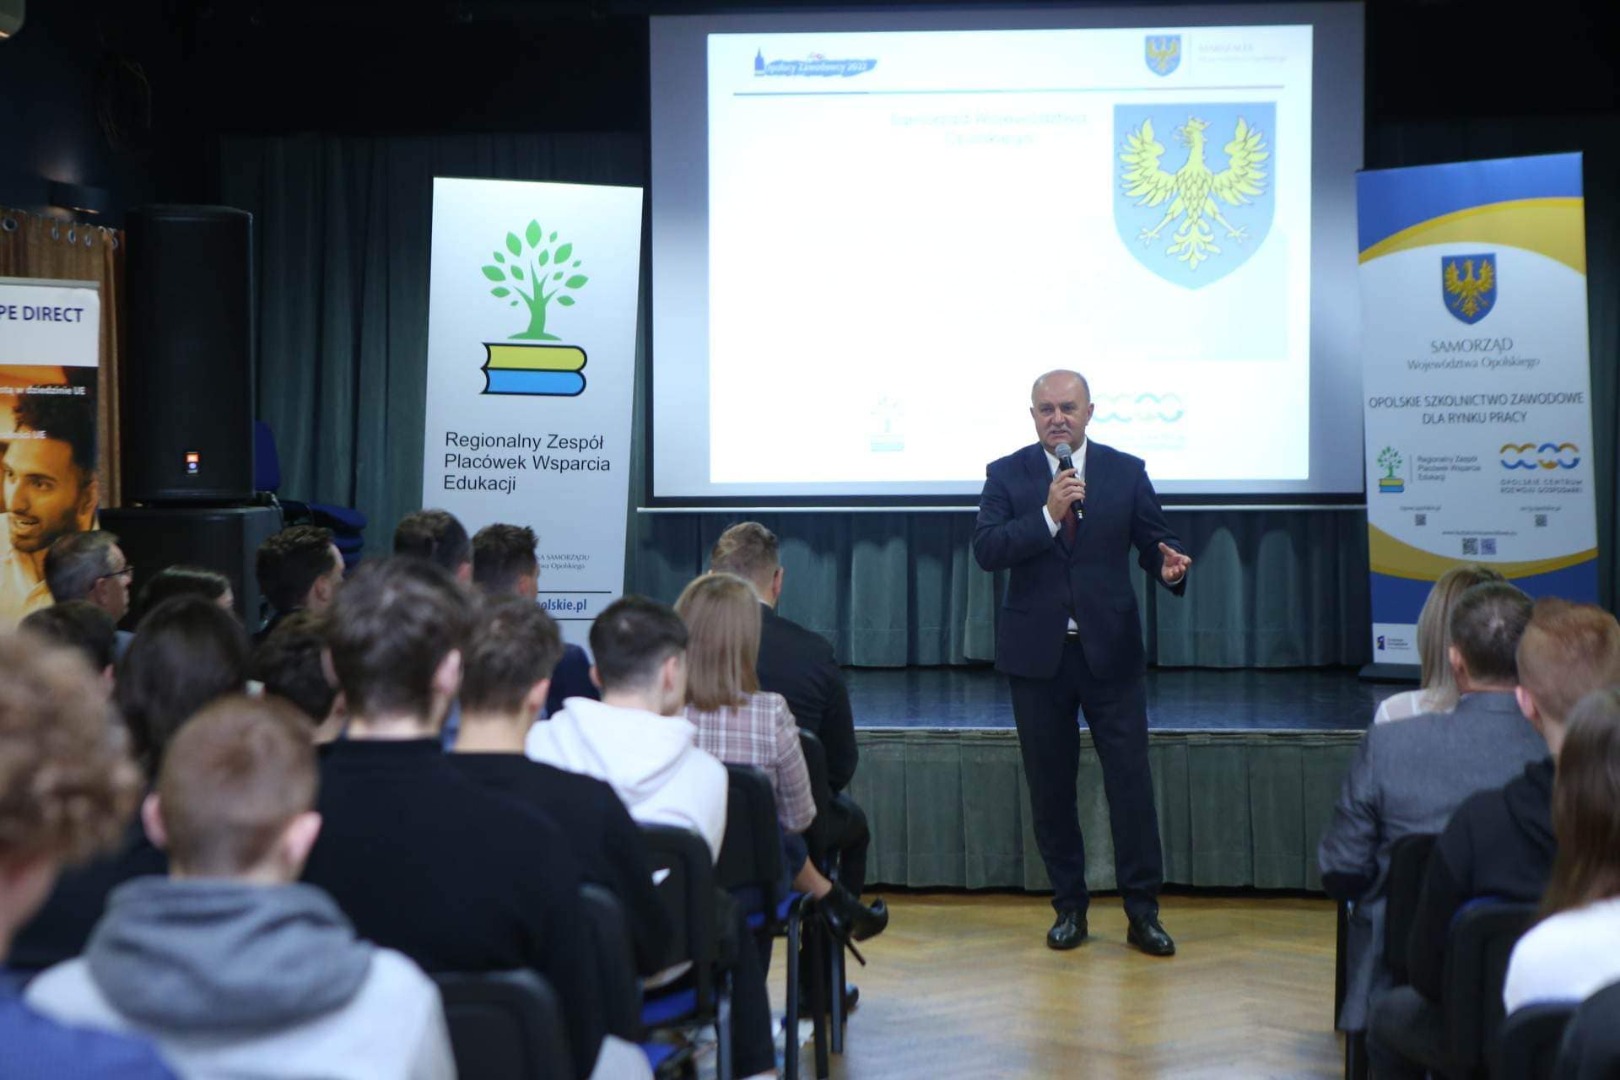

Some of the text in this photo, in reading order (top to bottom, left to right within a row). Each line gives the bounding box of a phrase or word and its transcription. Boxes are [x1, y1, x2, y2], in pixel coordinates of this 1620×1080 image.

[23, 305, 84, 322] DIRECT
[1431, 338, 1513, 354] SAMORZĄD
[1369, 391, 1584, 408] OPOLSKIE SZKOLNICTWO ZAWODOWE
[1422, 411, 1527, 425] DLA RYNKU PRACY
[445, 432, 604, 453] Regionalny Zespół
[444, 453, 610, 474] Placówek Wsparcia
[443, 475, 516, 495] Edukacji
